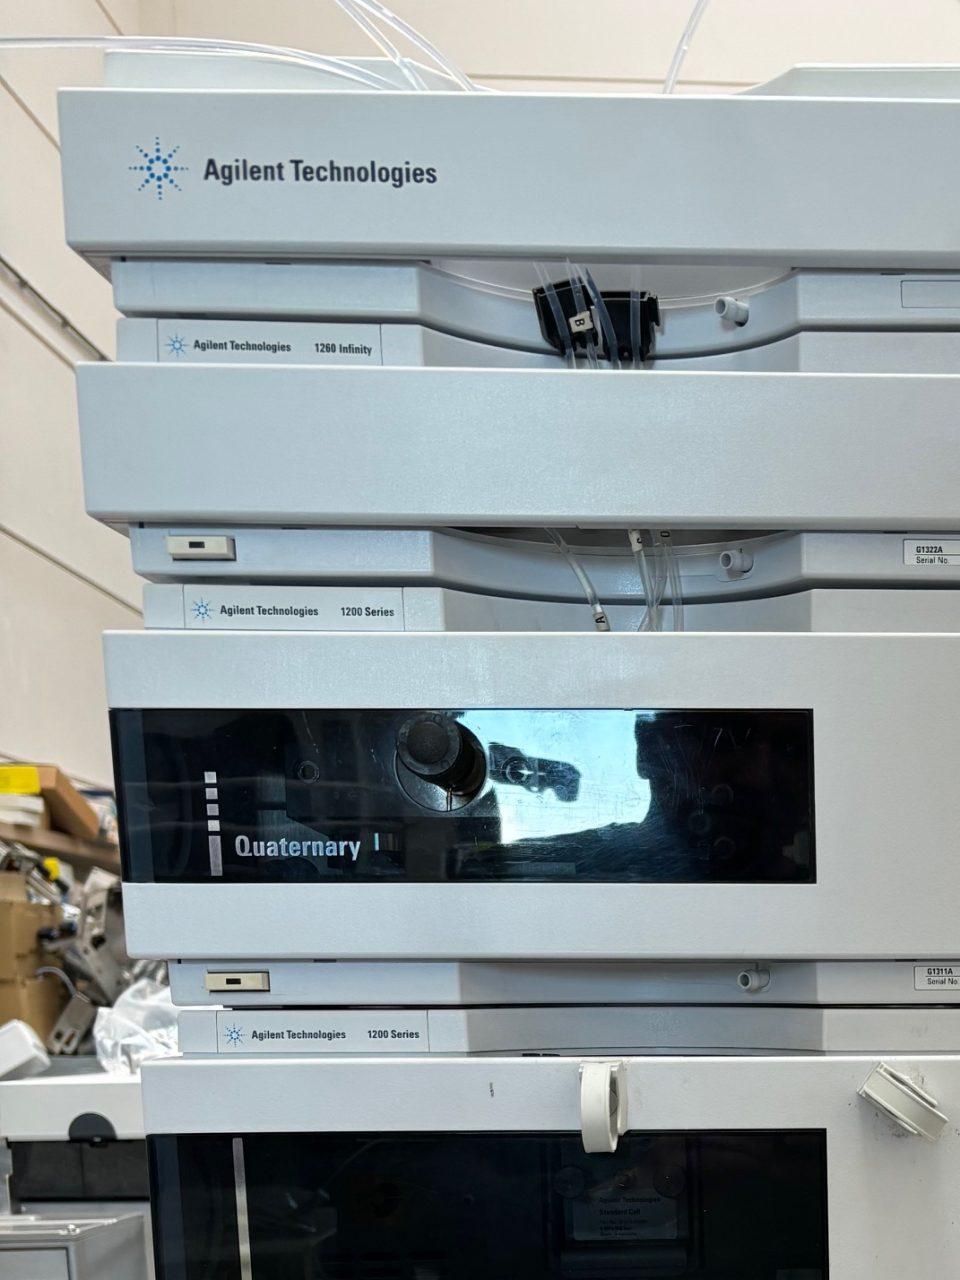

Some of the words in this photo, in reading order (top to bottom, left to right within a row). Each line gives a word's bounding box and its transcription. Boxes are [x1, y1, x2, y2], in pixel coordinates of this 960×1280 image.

[203, 158, 284, 186] Agilent
[290, 159, 437, 189] Technologies
[575, 318, 585, 326] B
[193, 339, 227, 351] Agilent
[230, 340, 291, 353] Technologies
[315, 343, 336, 353] 1260
[339, 343, 372, 356] Infinity
[916, 546, 944, 554] G1322A
[916, 556, 936, 564] Serial
[220, 605, 255, 616] Agilent
[257, 606, 319, 617] Technologies
[341, 606, 363, 617] 1200
[365, 606, 395, 617] Series
[595, 615, 605, 623] A
[235, 835, 361, 861] Quaternary
[251, 1029, 284, 1041] Agilent
[286, 1030, 346, 1041] Technologies
[367, 1030, 389, 1039] 1200
[390, 1029, 420, 1039] Series
